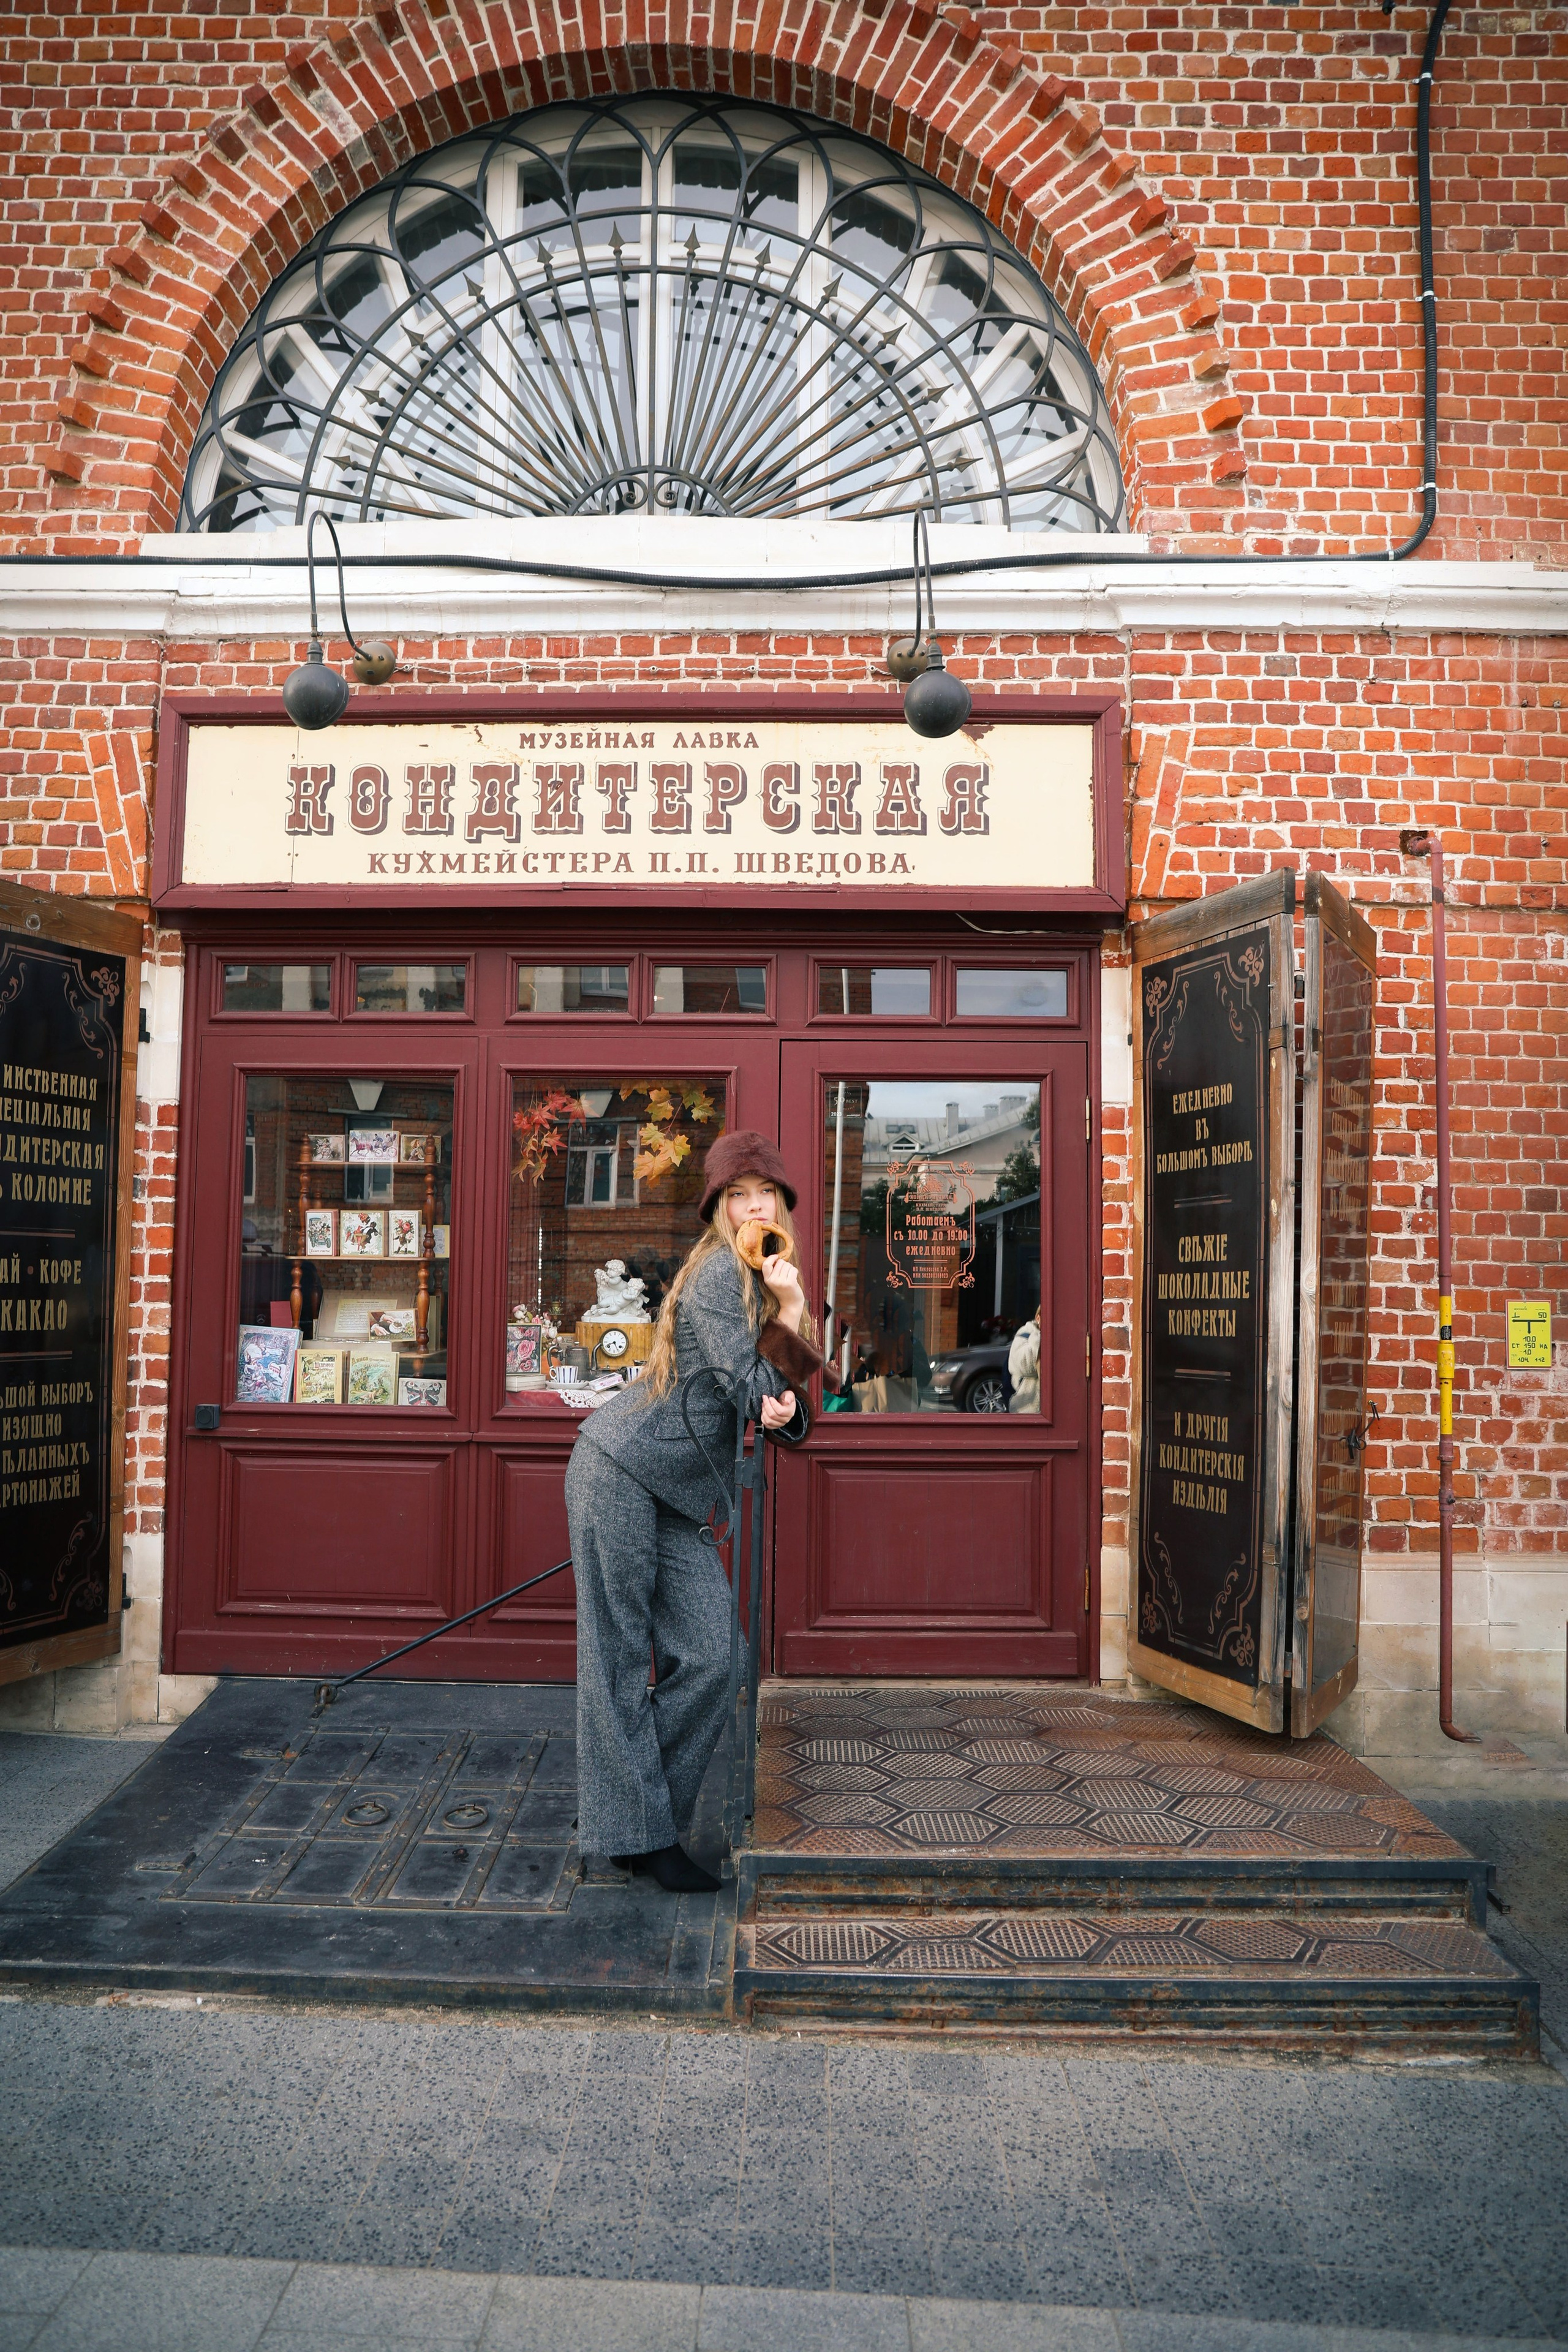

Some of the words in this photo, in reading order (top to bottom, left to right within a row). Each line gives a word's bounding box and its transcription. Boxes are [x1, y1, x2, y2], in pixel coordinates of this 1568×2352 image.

[519, 728, 654, 749] МУЗЕЙНАЯ
[673, 731, 760, 748] ЛАВКА
[284, 761, 990, 843] КОНДИТЕРСКАЯ
[367, 850, 635, 874] КУХМЕЙСТЕРА
[647, 852, 719, 873] П.П.
[733, 852, 911, 878] ШВЕДОВА
[1172, 1082, 1233, 1115] ЕЖЕДНЕВНО
[1196, 1117, 1209, 1140] ВЪ
[0, 1133, 104, 1170] ДИТЕРСКАЯ
[1156, 1147, 1208, 1174] БОЛЬШОМЪ
[1212, 1140, 1253, 1166] ВЫБОРѢ
[12, 1172, 91, 1205] КОЛОМНЕ
[906, 1214, 956, 1226] Работаемъ
[894, 1231, 904, 1240] съ
[907, 1229, 928, 1241] 10.00
[932, 1231, 943, 1241] до
[1178, 1234, 1227, 1262] СВѢЖІЕ
[906, 1245, 956, 1256] ежедневно
[40, 1259, 81, 1284] КОФЕ
[1158, 1271, 1250, 1300] ШОКОЛАДНЫЕ
[1, 1299, 67, 1331] КАКАО
[1168, 1309, 1236, 1337] КОНФЕКТЫ
[41, 1382, 94, 1406] ВЫБОРЪ
[2, 1413, 62, 1441] ИЗЯЩНО
[1174, 1412, 1181, 1437] И
[1186, 1412, 1229, 1443] ДРУГІЯ
[1159, 1443, 1245, 1482] КОНДИТЕРСКІЯ
[1172, 1479, 1227, 1515] ИЗДѢЛІЯ
